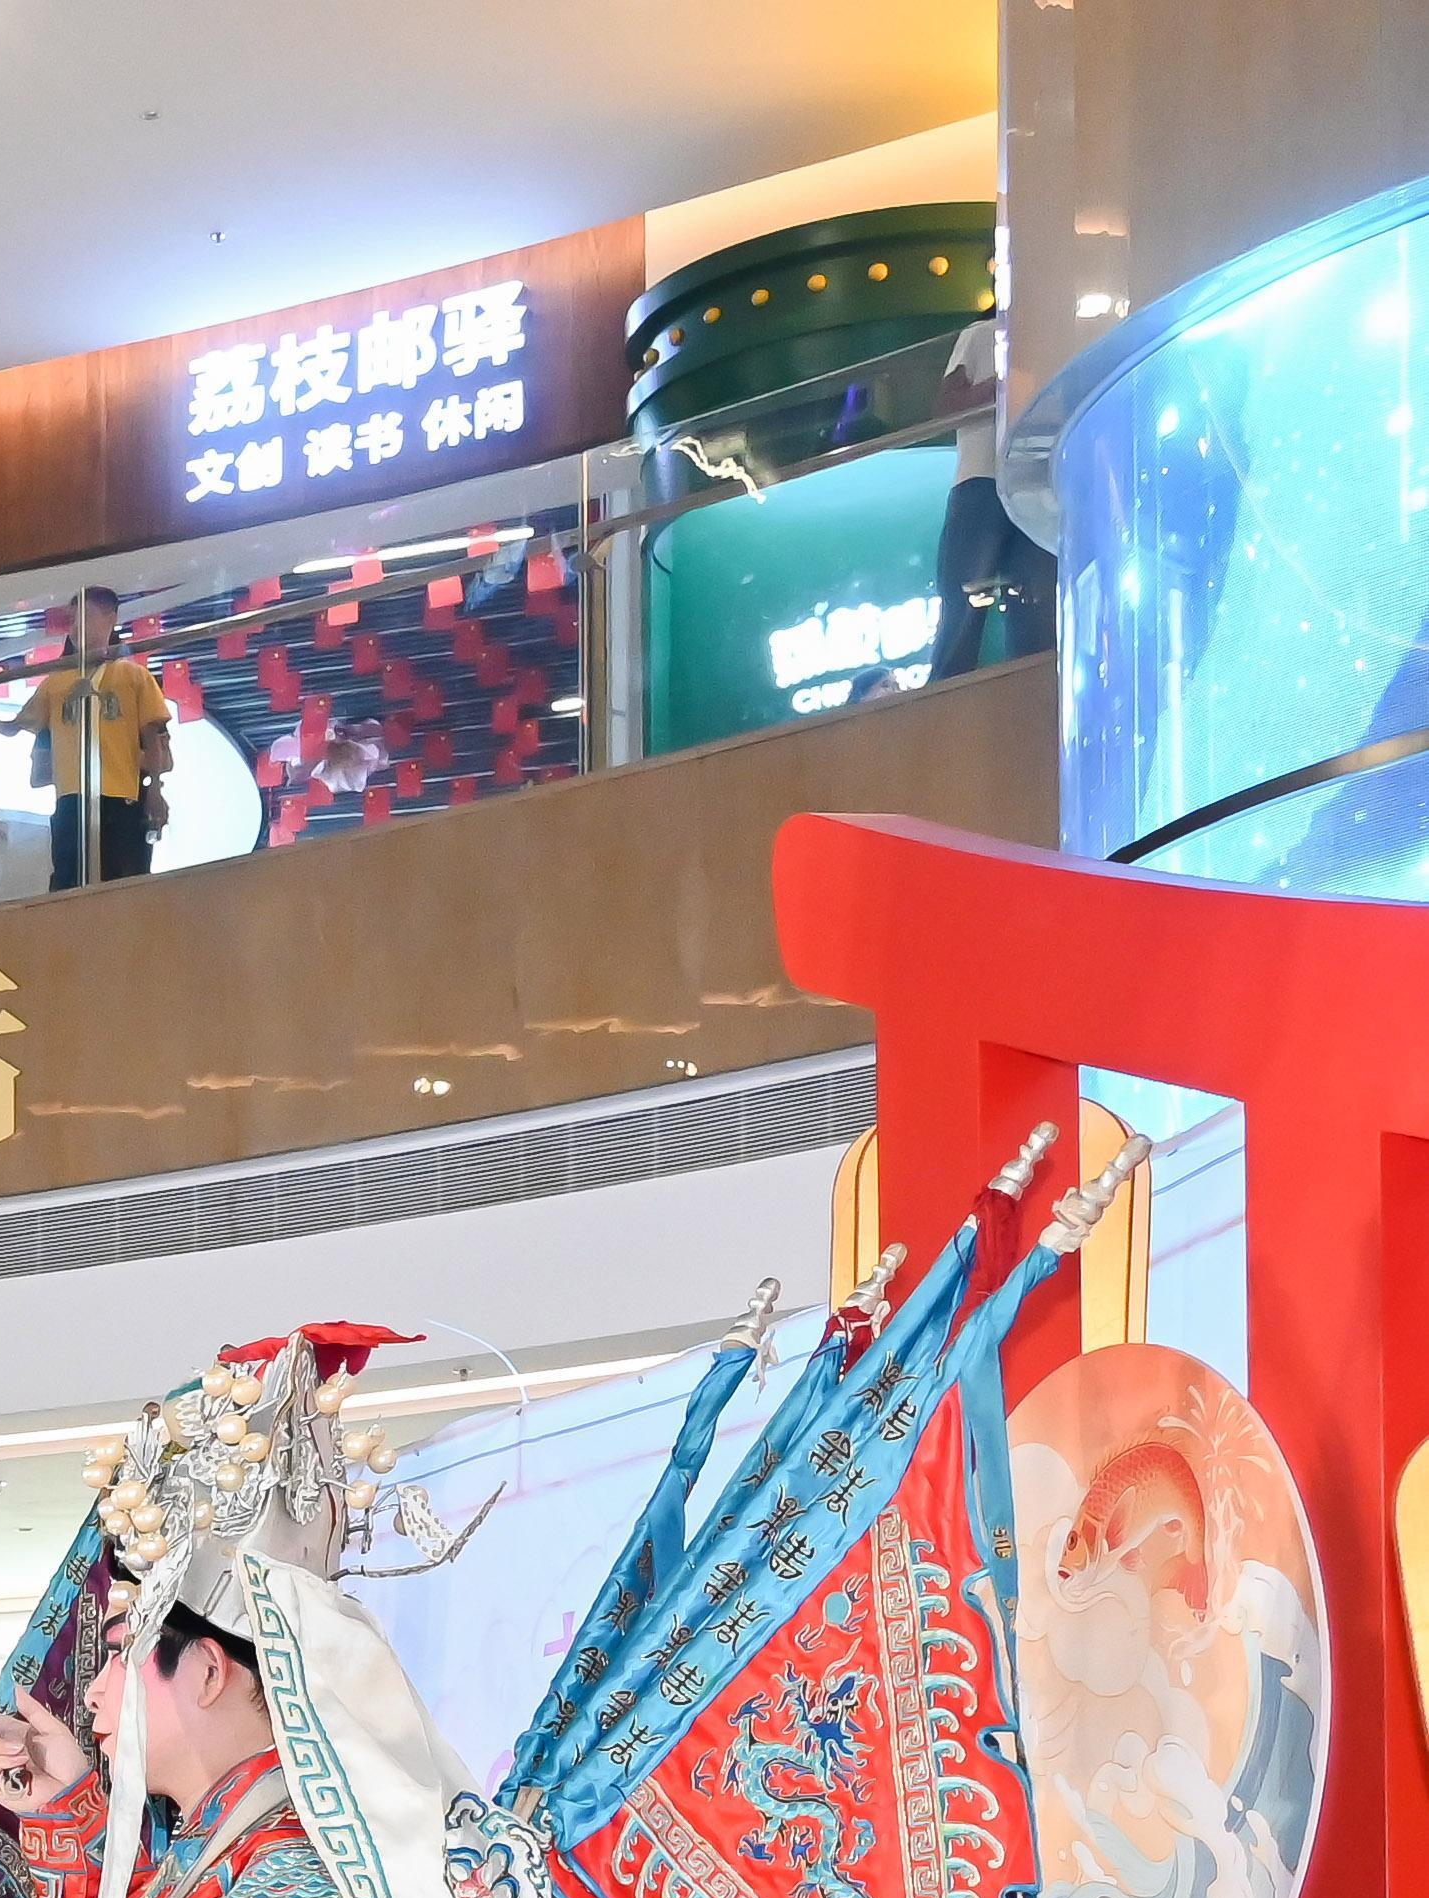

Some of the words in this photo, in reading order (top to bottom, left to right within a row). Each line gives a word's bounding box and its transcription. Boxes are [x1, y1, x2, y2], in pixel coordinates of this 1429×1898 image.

[187, 280, 527, 437] 荔枝邮驿
[185, 436, 283, 502] 文创
[303, 411, 403, 477] 读书
[421, 380, 525, 451] 休闲
